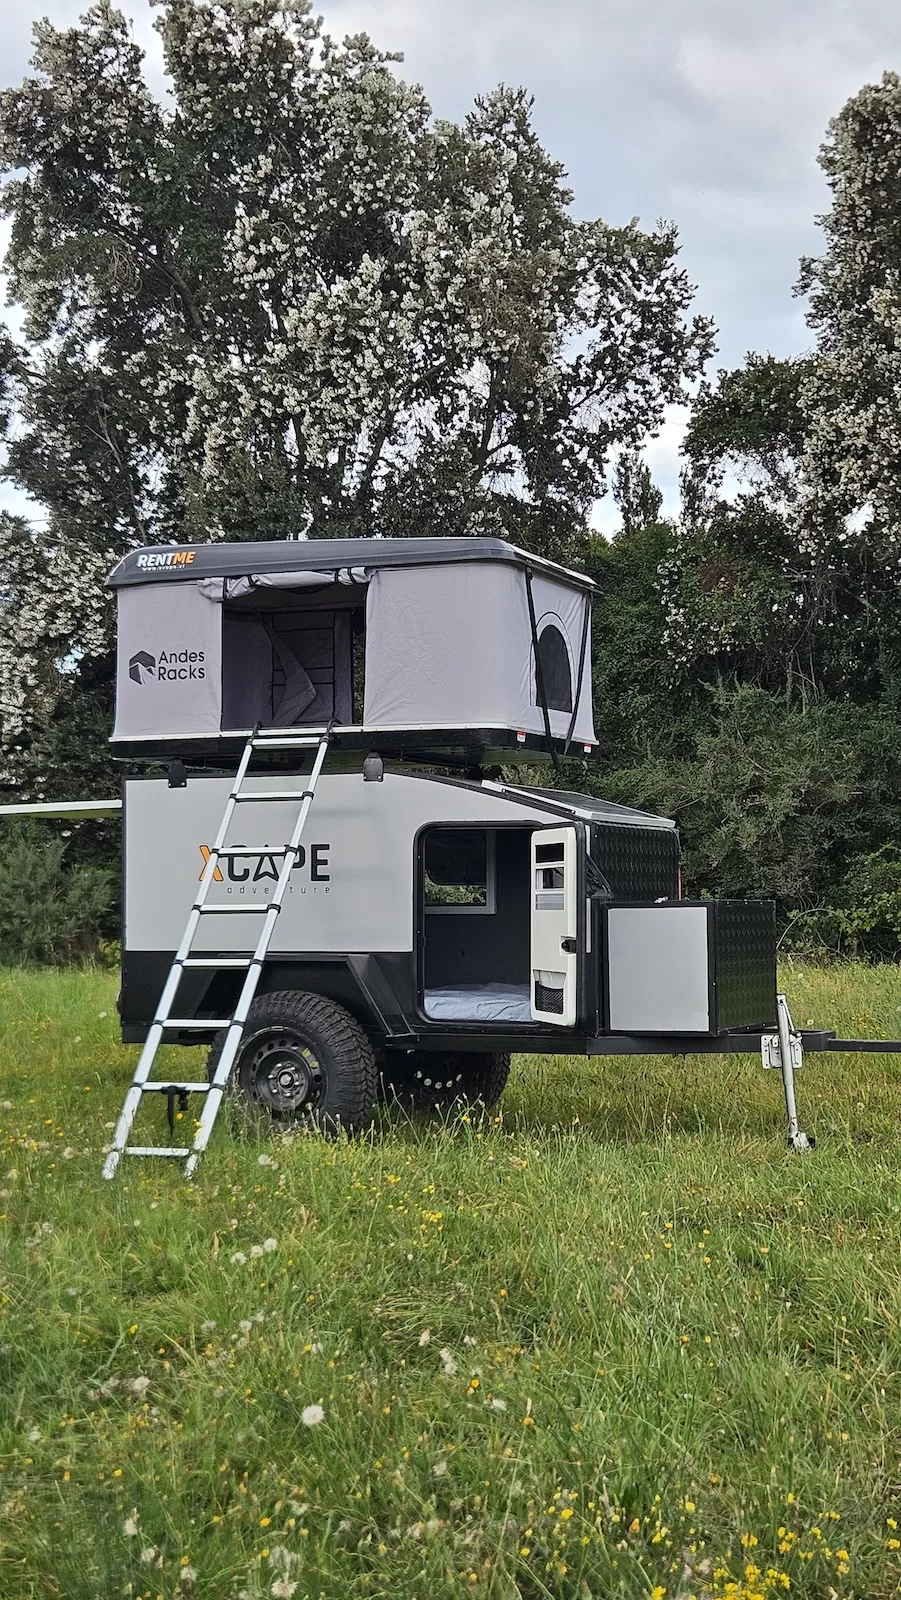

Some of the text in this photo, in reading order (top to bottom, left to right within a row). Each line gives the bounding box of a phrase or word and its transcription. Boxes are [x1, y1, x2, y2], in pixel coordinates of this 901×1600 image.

[136, 551, 197, 568] RENTME
[158, 649, 205, 665] Andes
[158, 664, 206, 681] Racks
[226, 885, 331, 895] adveture
